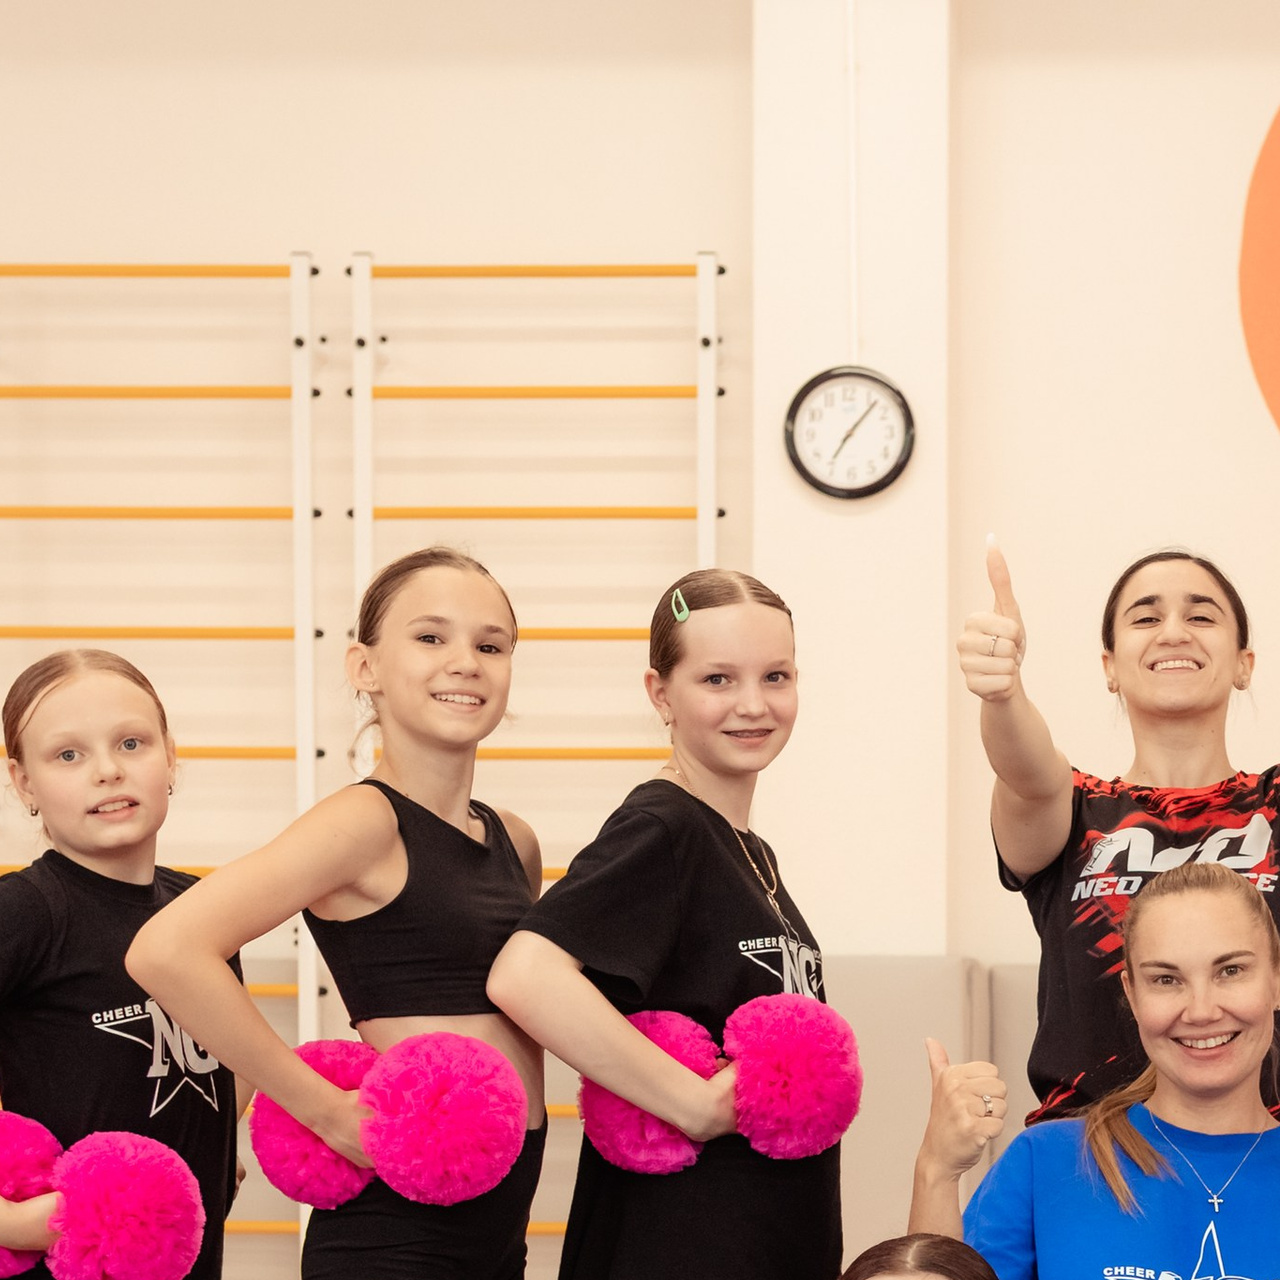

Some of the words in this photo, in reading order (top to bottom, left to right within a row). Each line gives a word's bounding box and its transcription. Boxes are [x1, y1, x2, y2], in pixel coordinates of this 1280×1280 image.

[841, 386, 858, 402] 12
[1071, 875, 1143, 902] NEO
[738, 935, 780, 951] CHEER
[91, 1003, 143, 1024] CHEER
[1102, 1266, 1156, 1279] CHEER
